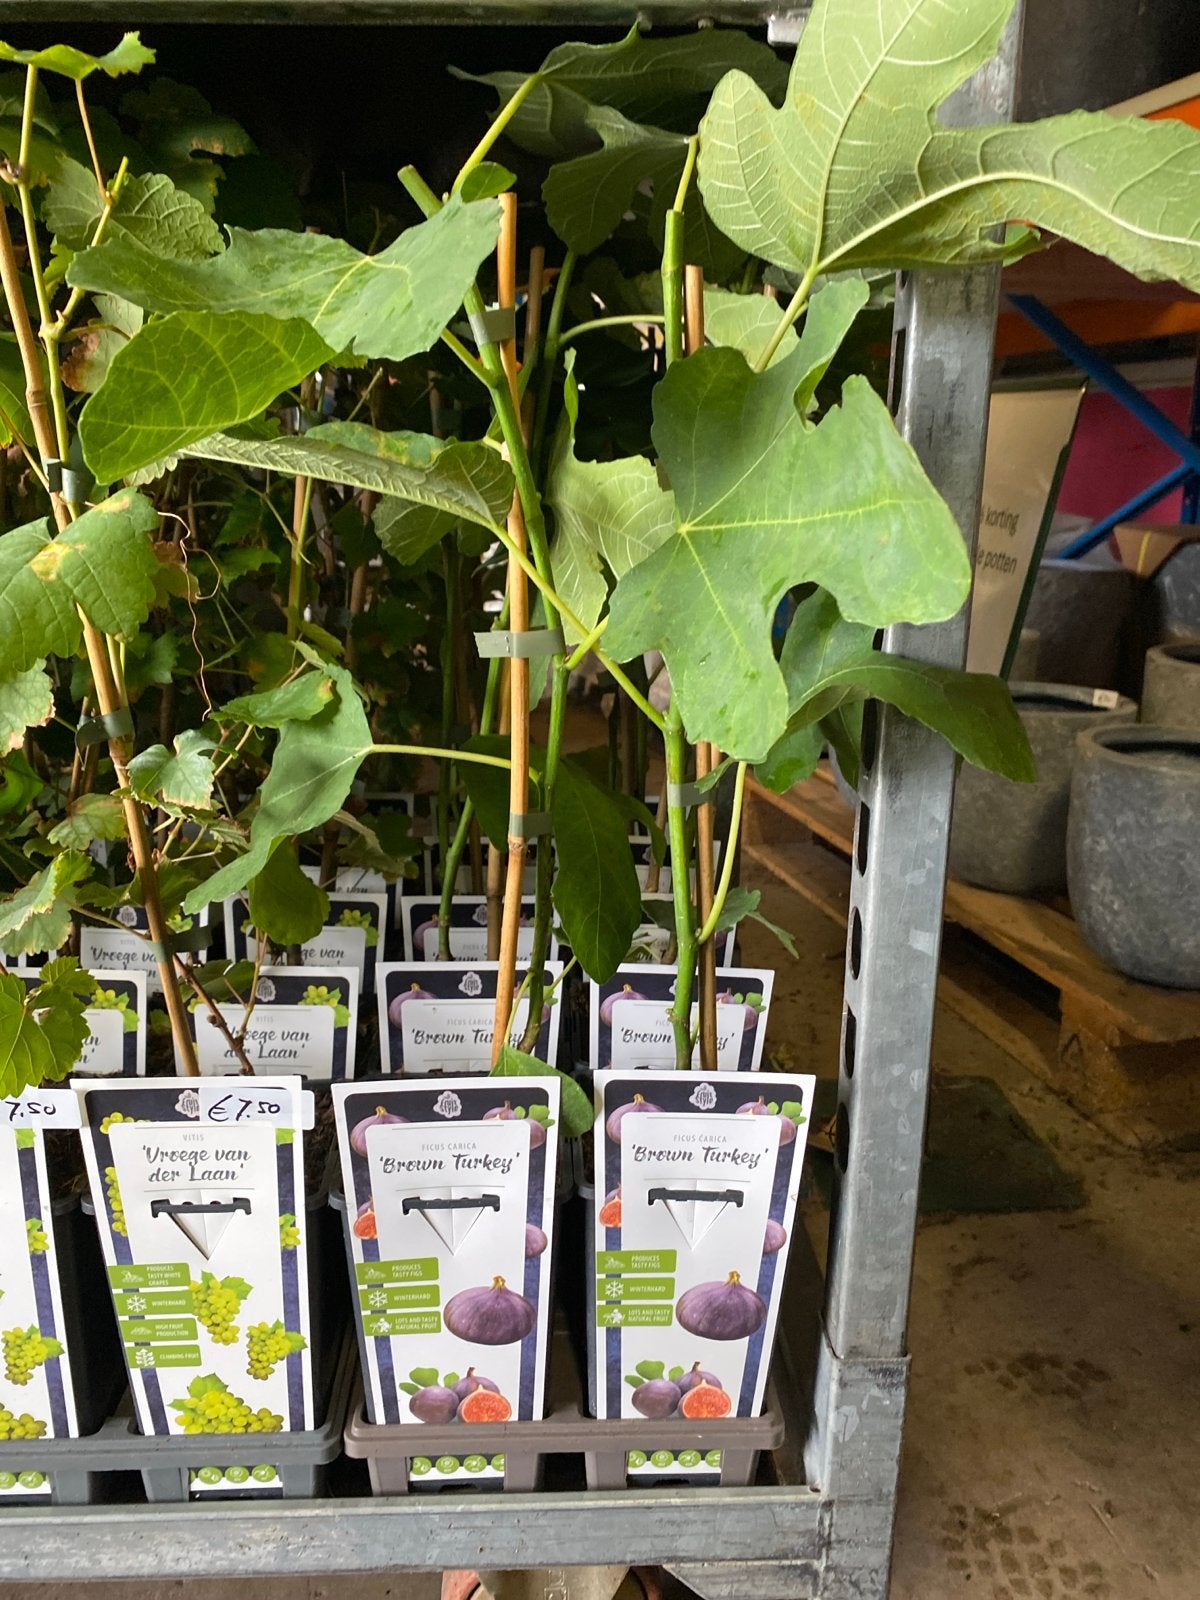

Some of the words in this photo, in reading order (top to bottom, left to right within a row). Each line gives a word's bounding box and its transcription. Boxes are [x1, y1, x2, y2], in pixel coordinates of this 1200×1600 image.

[985, 506, 1020, 537] korting
[983, 552, 1018, 575] potten
[320, 948, 345, 959] van
[281, 1030, 311, 1041] van
[411, 1028, 467, 1045] 'Brown
[182, 1134, 205, 1142] VITIS
[673, 1134, 696, 1142] FICUS
[698, 1135, 727, 1143] CARICA
[448, 1142, 477, 1150] CARICA
[142, 1145, 210, 1166] 'Vroege
[215, 1149, 251, 1162] van
[631, 1143, 695, 1162] 'Brown
[701, 1145, 769, 1169] Turkey'
[379, 1155, 446, 1174] 'Brown
[452, 1151, 521, 1174] Turkey'
[148, 1167, 181, 1182] der
[188, 1163, 244, 1182] Laan'
[392, 1264, 421, 1272] PRODUCES
[629, 1285, 666, 1293] WINTERHARD
[393, 1293, 431, 1301] WINTERHARD
